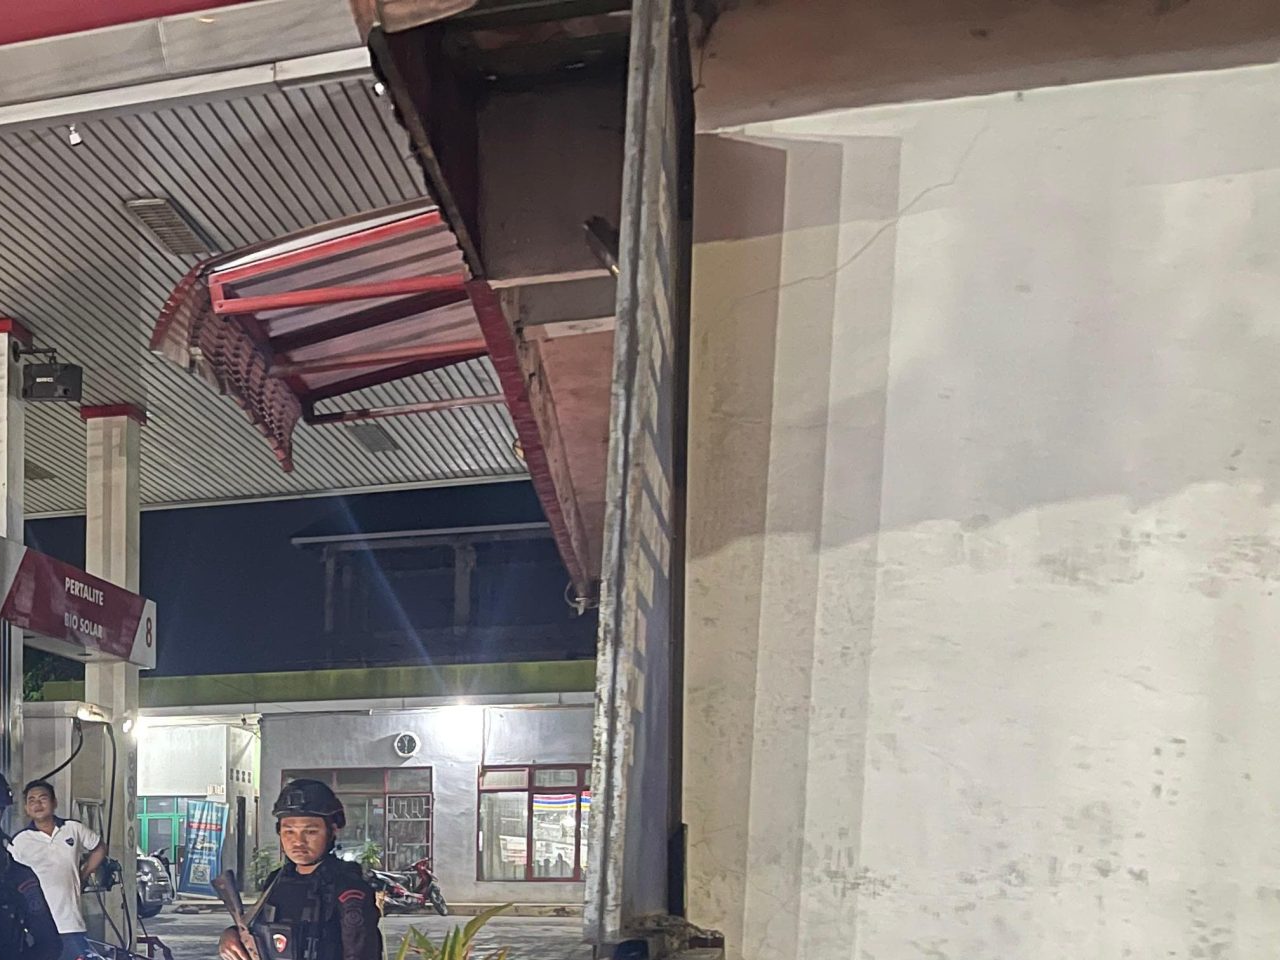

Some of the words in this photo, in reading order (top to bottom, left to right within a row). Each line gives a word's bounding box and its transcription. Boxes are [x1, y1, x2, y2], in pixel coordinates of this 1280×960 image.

[64, 577, 104, 606] PERTALITE
[79, 618, 103, 640] SOLAR
[145, 616, 153, 648] 8
